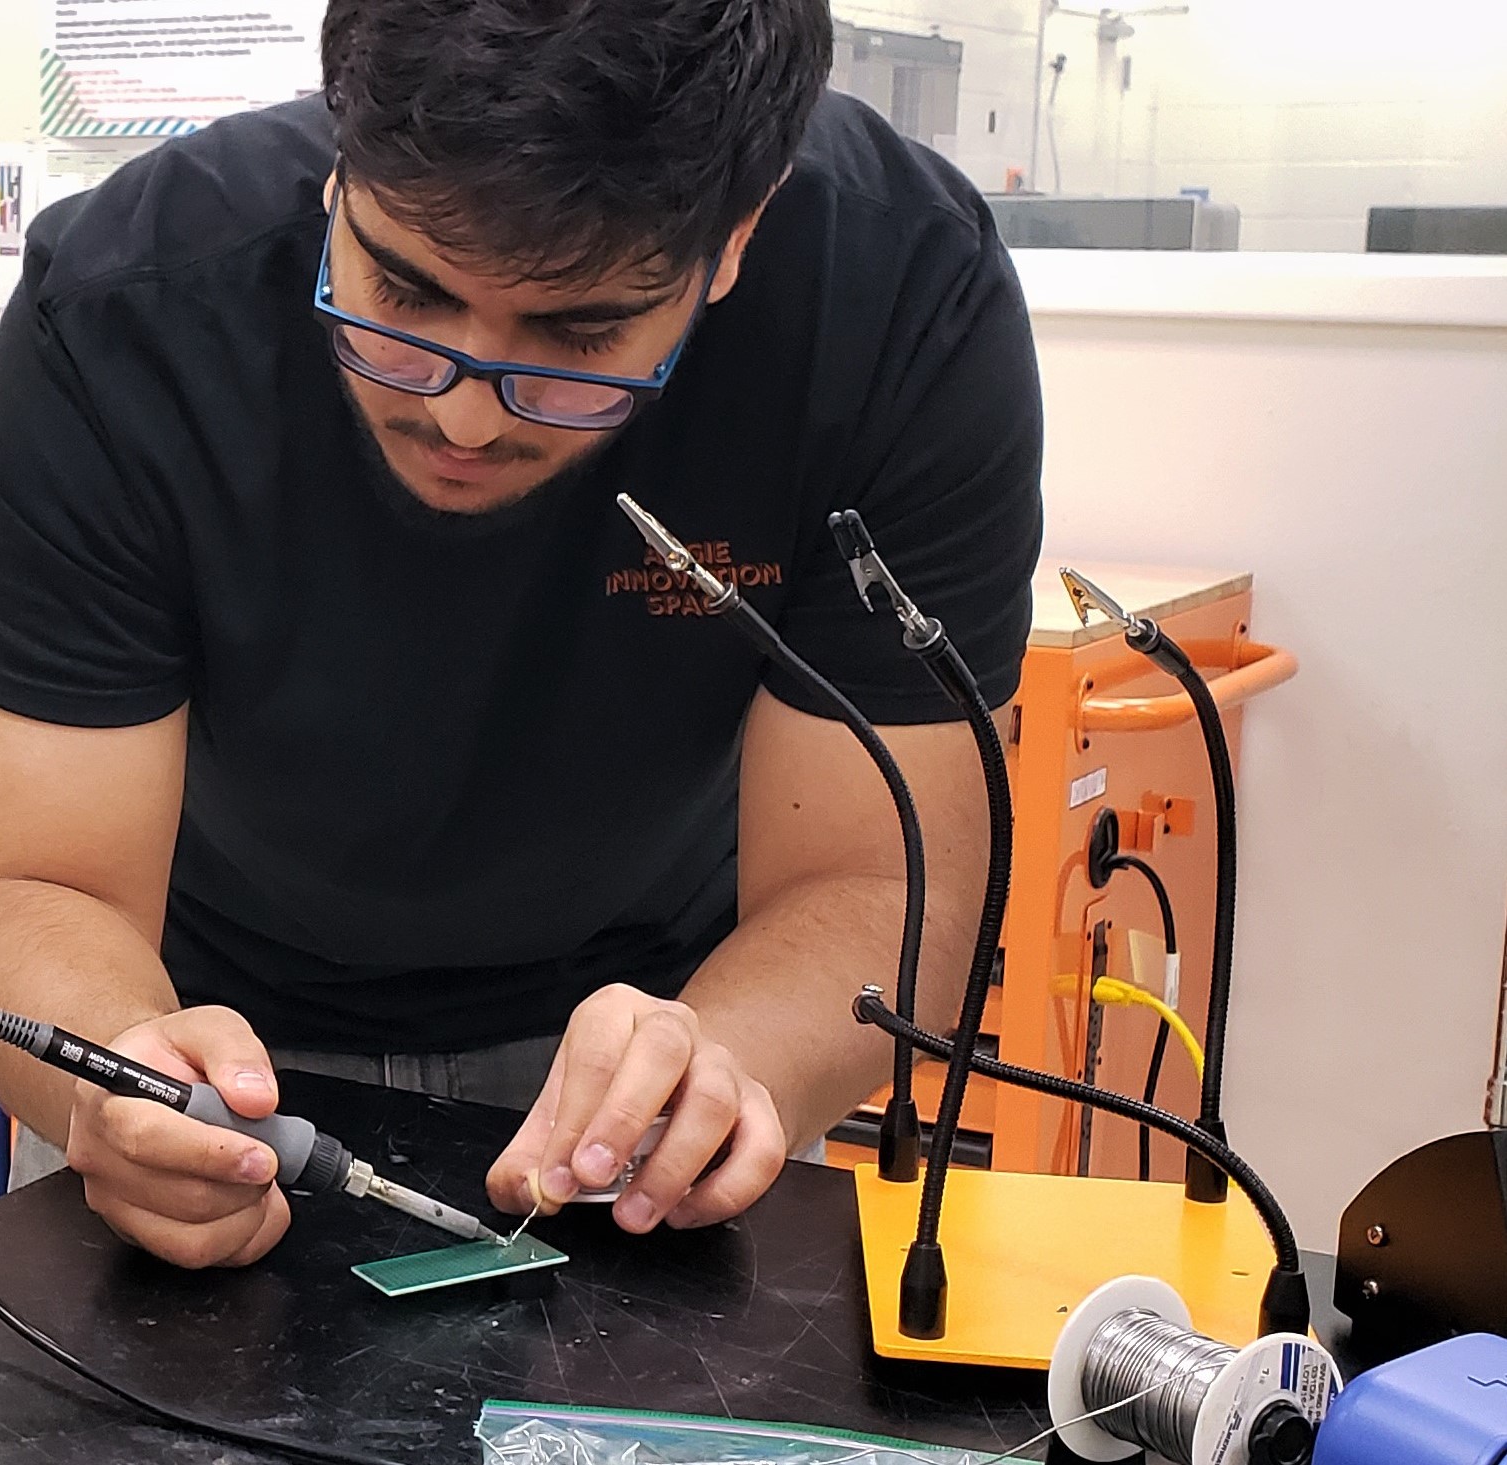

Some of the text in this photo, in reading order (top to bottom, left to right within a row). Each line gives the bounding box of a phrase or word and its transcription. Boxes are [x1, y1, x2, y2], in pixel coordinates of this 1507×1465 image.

[644, 541, 732, 566] AGIE
[606, 562, 782, 596] INNOVTION
[1214, 1410, 1243, 1465] AMERWA
